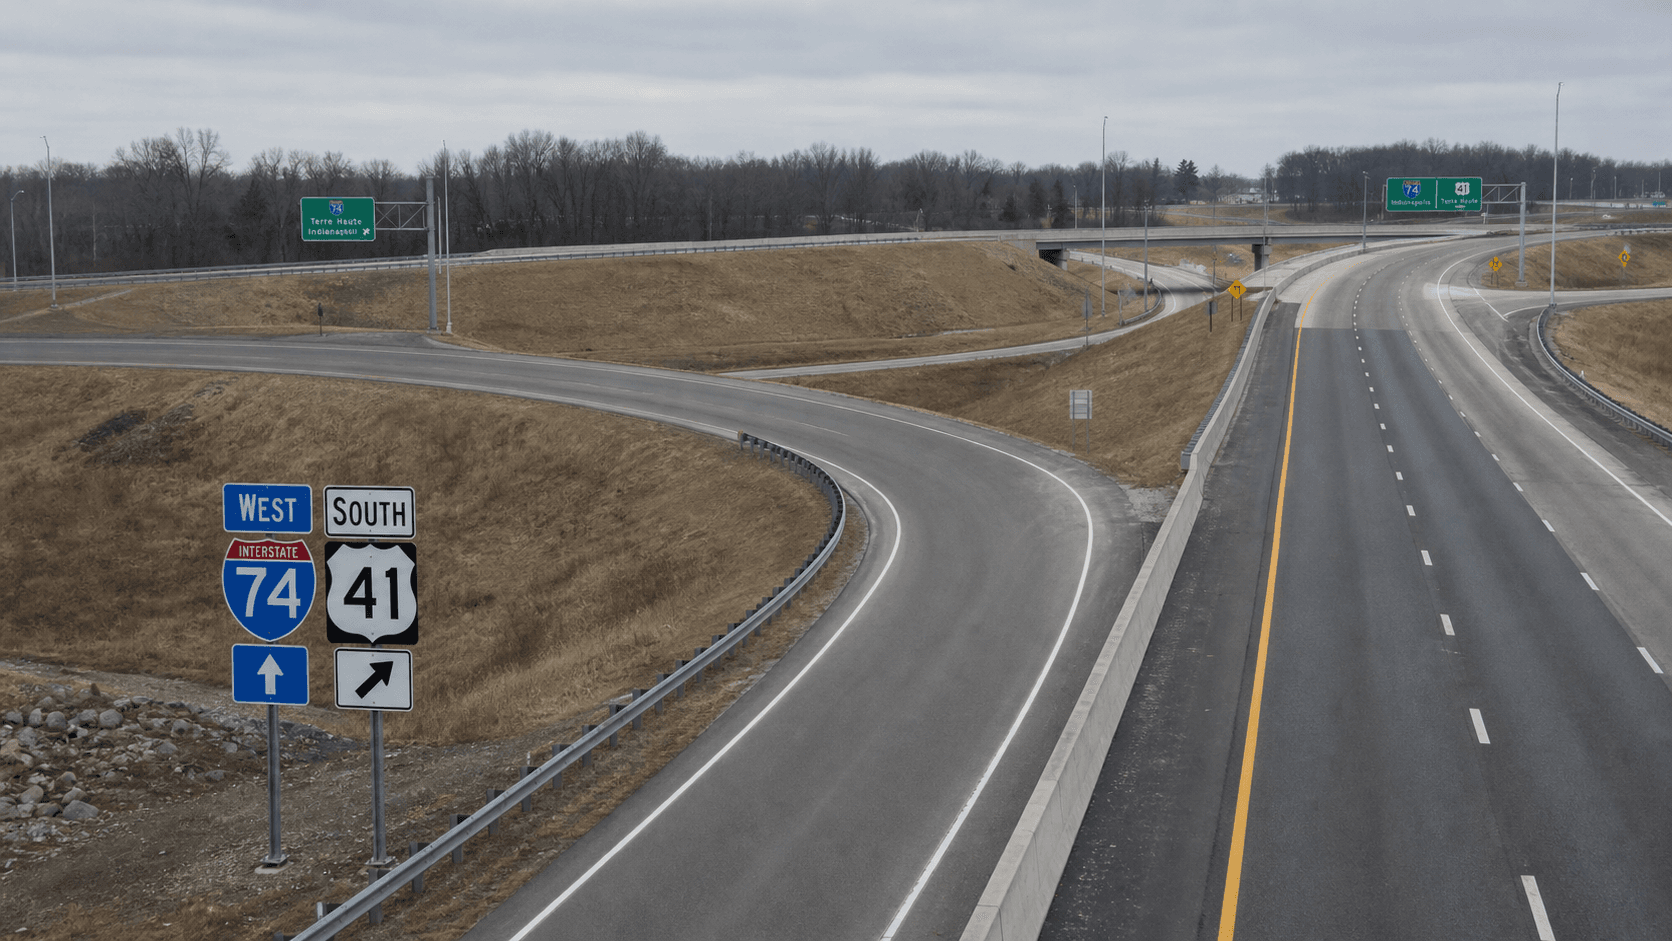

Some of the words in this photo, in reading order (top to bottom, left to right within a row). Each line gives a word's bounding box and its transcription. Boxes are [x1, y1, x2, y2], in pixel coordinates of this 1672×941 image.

[1405, 184, 1419, 195] 74
[1457, 184, 1468, 193] 41
[310, 217, 333, 225] Terre
[337, 217, 362, 225] Haute
[238, 493, 297, 522] WEST
[333, 496, 406, 527] SOUTH
[238, 545, 298, 559] INTERSTATE
[236, 566, 301, 619] 74
[343, 566, 399, 620] 41
